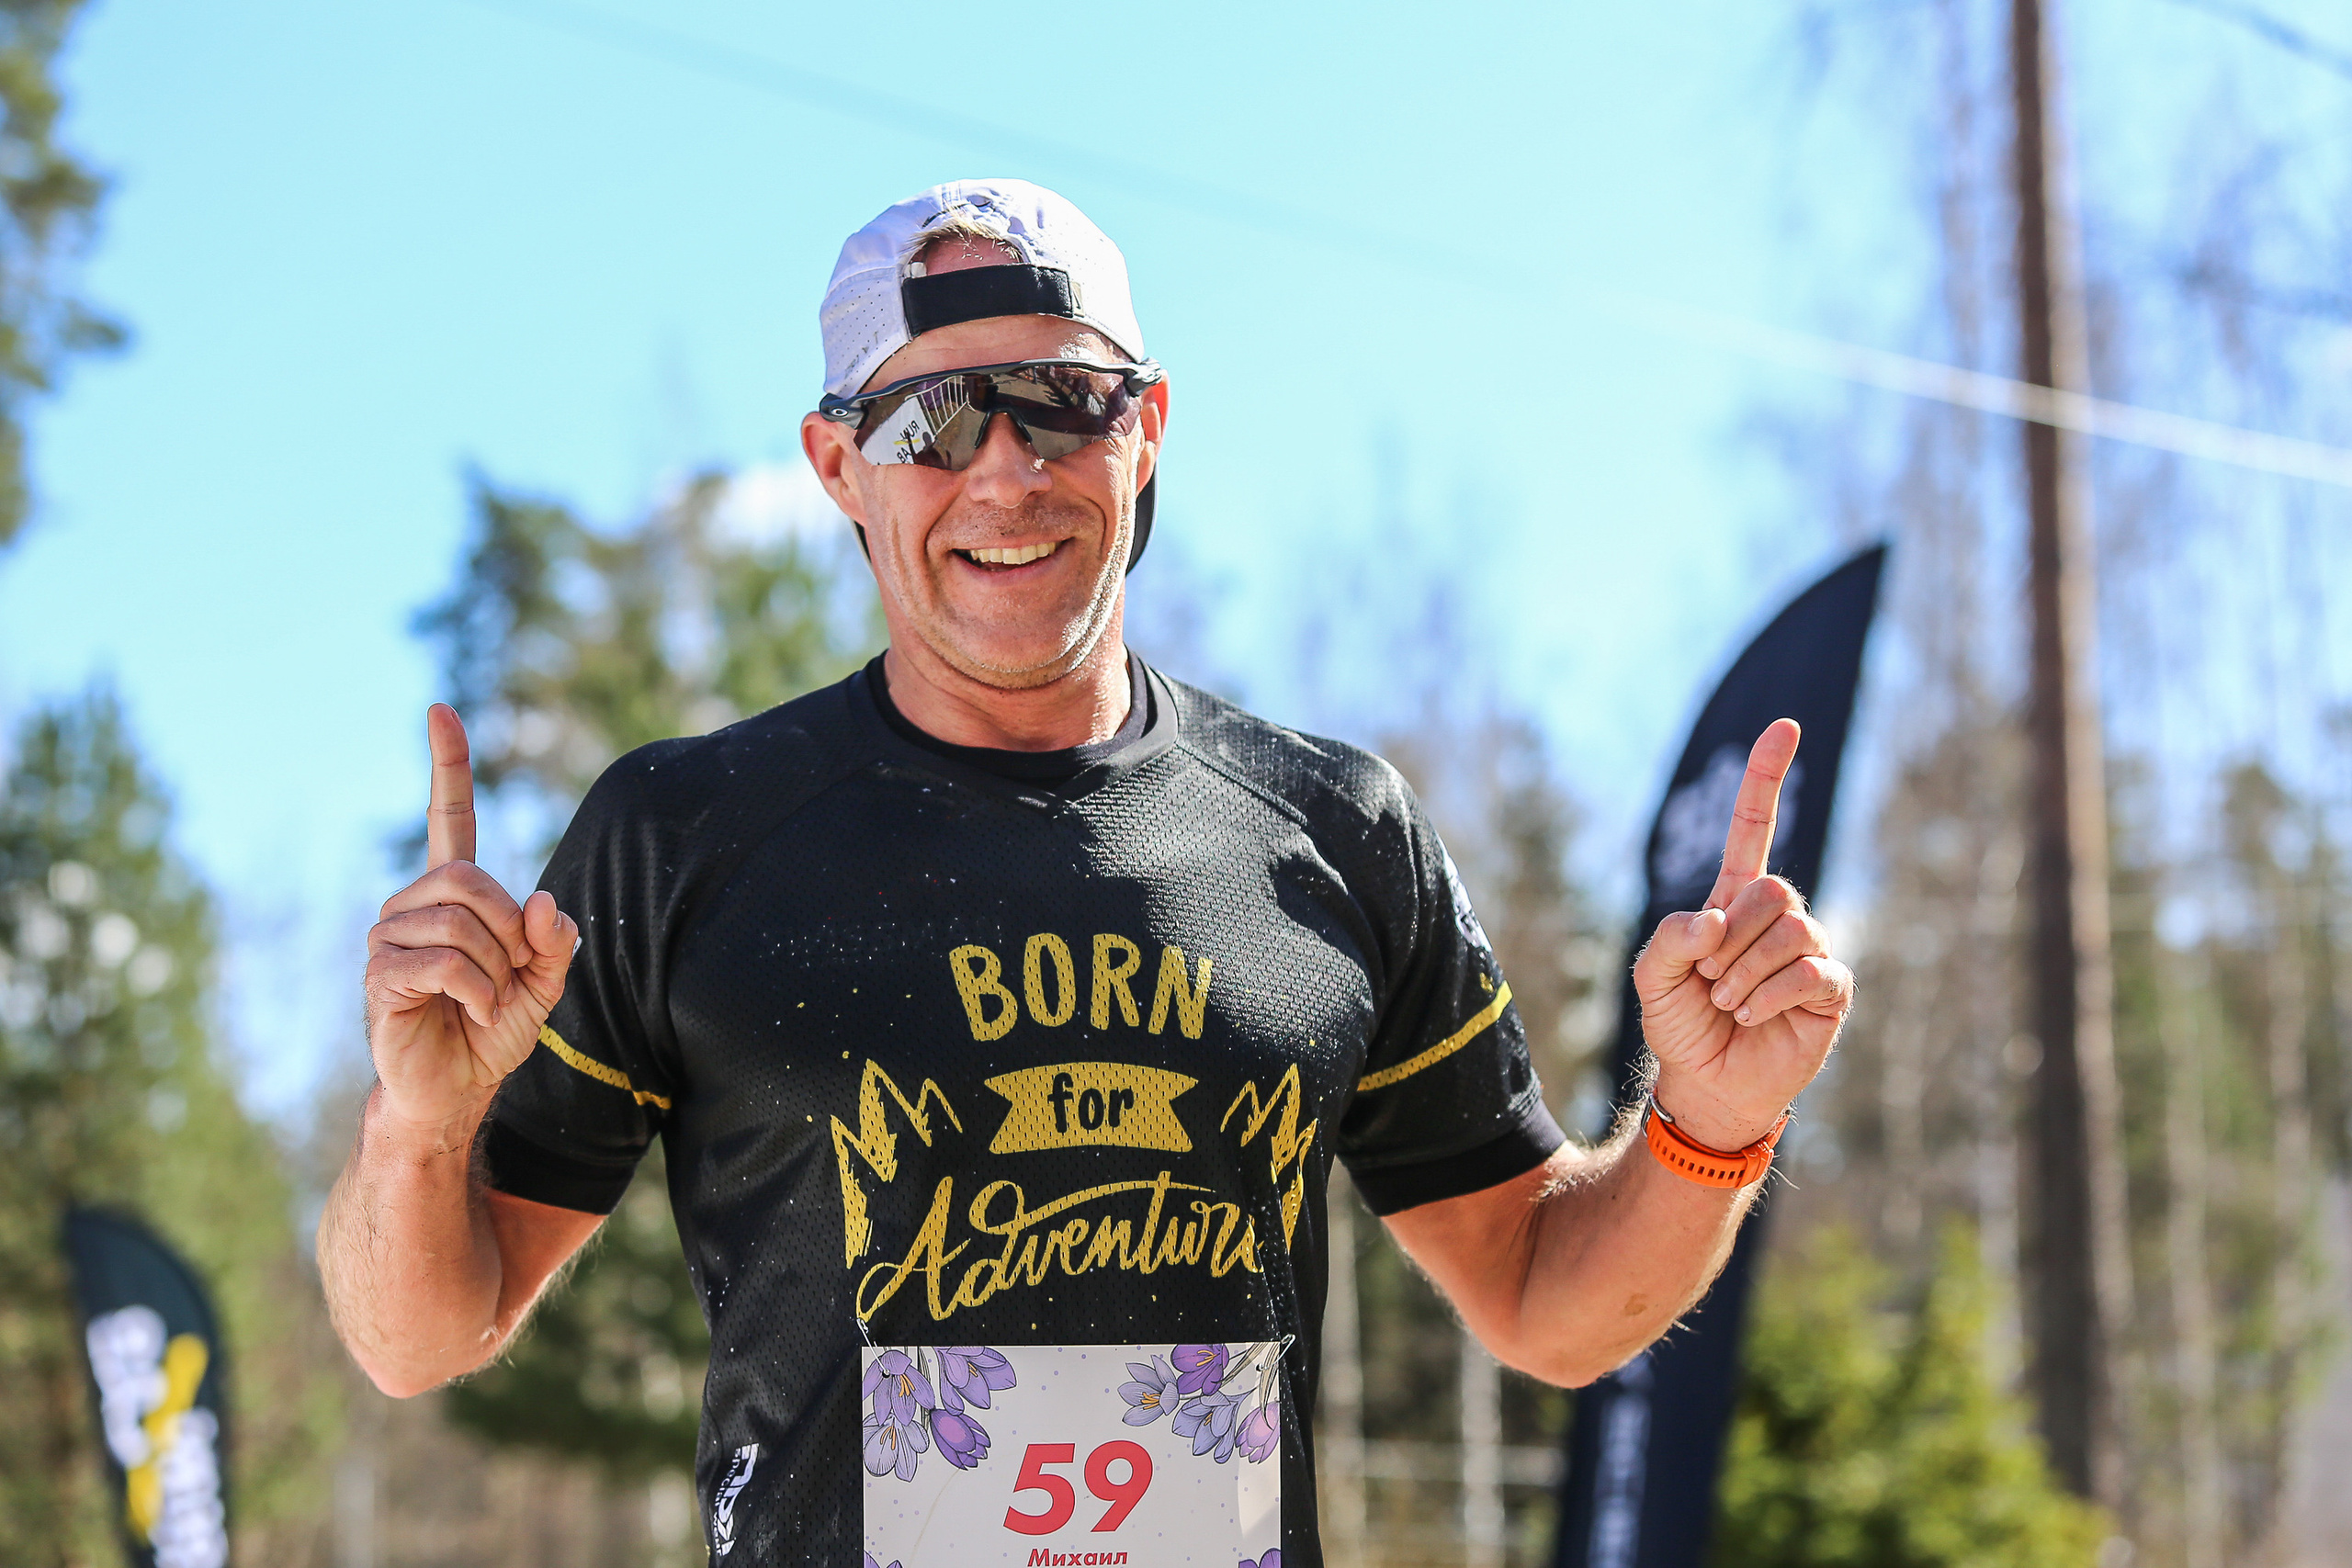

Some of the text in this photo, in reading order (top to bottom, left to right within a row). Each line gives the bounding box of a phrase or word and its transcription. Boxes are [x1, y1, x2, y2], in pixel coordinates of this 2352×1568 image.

[949, 932, 1213, 1042] BORN
[1047, 1072, 1135, 1134] for
[1002, 1439, 1154, 1536] 59
[1027, 1548, 1128, 1567] Михаил
